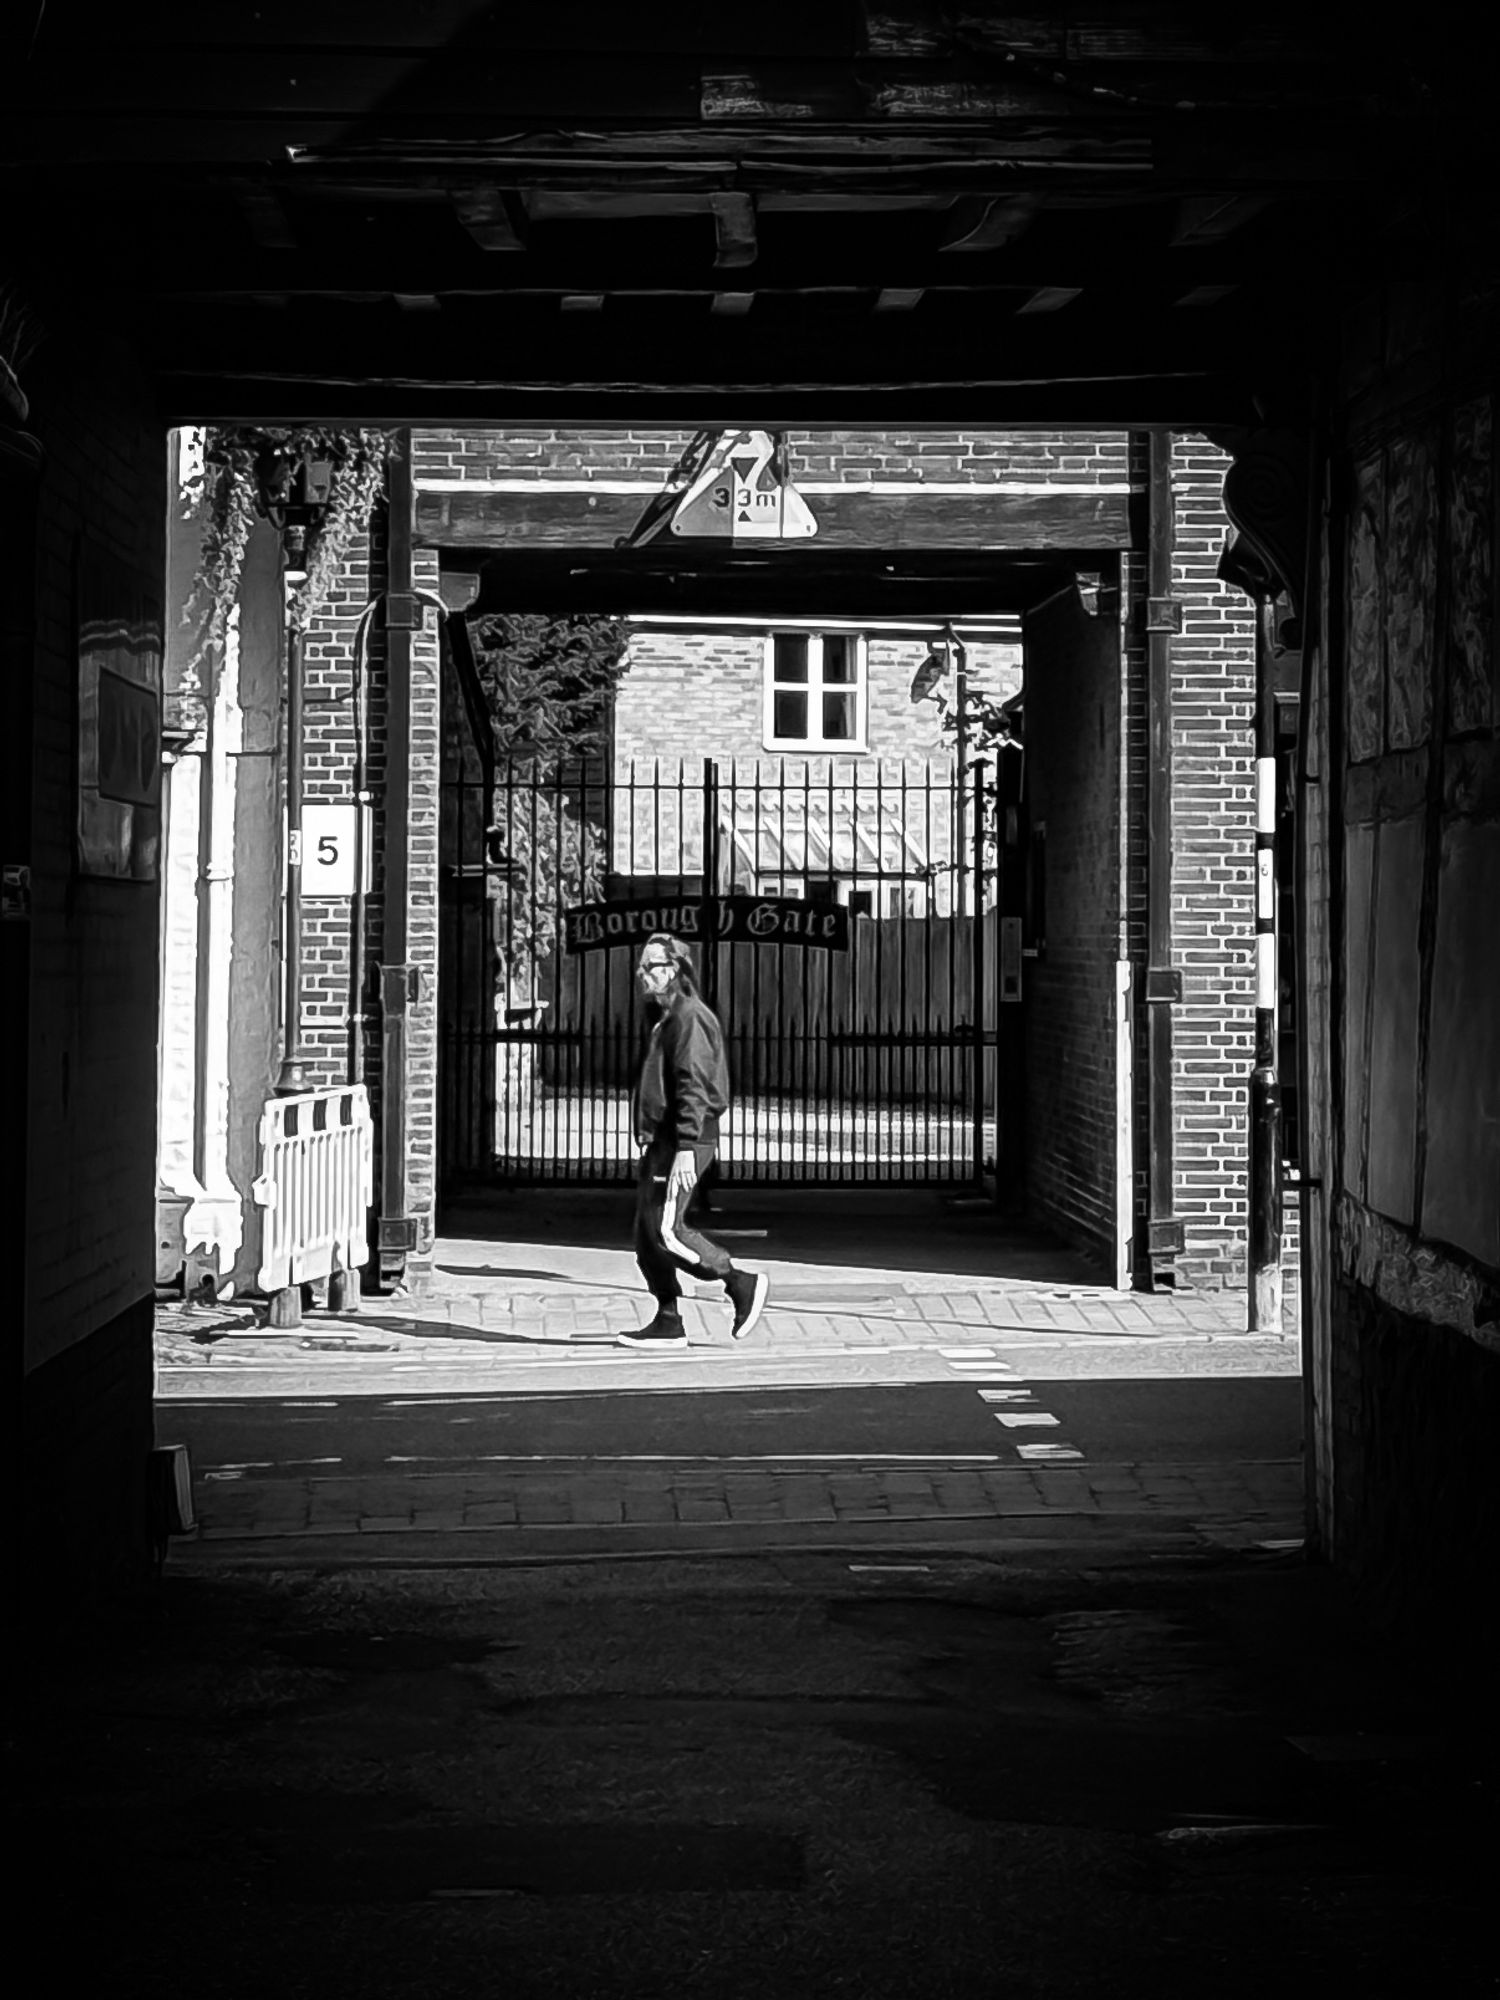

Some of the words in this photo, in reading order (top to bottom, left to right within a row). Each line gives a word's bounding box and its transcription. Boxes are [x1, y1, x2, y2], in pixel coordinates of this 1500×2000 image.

[317, 836, 339, 866] 5
[571, 900, 734, 944] Borough
[746, 903, 837, 938] Gate
